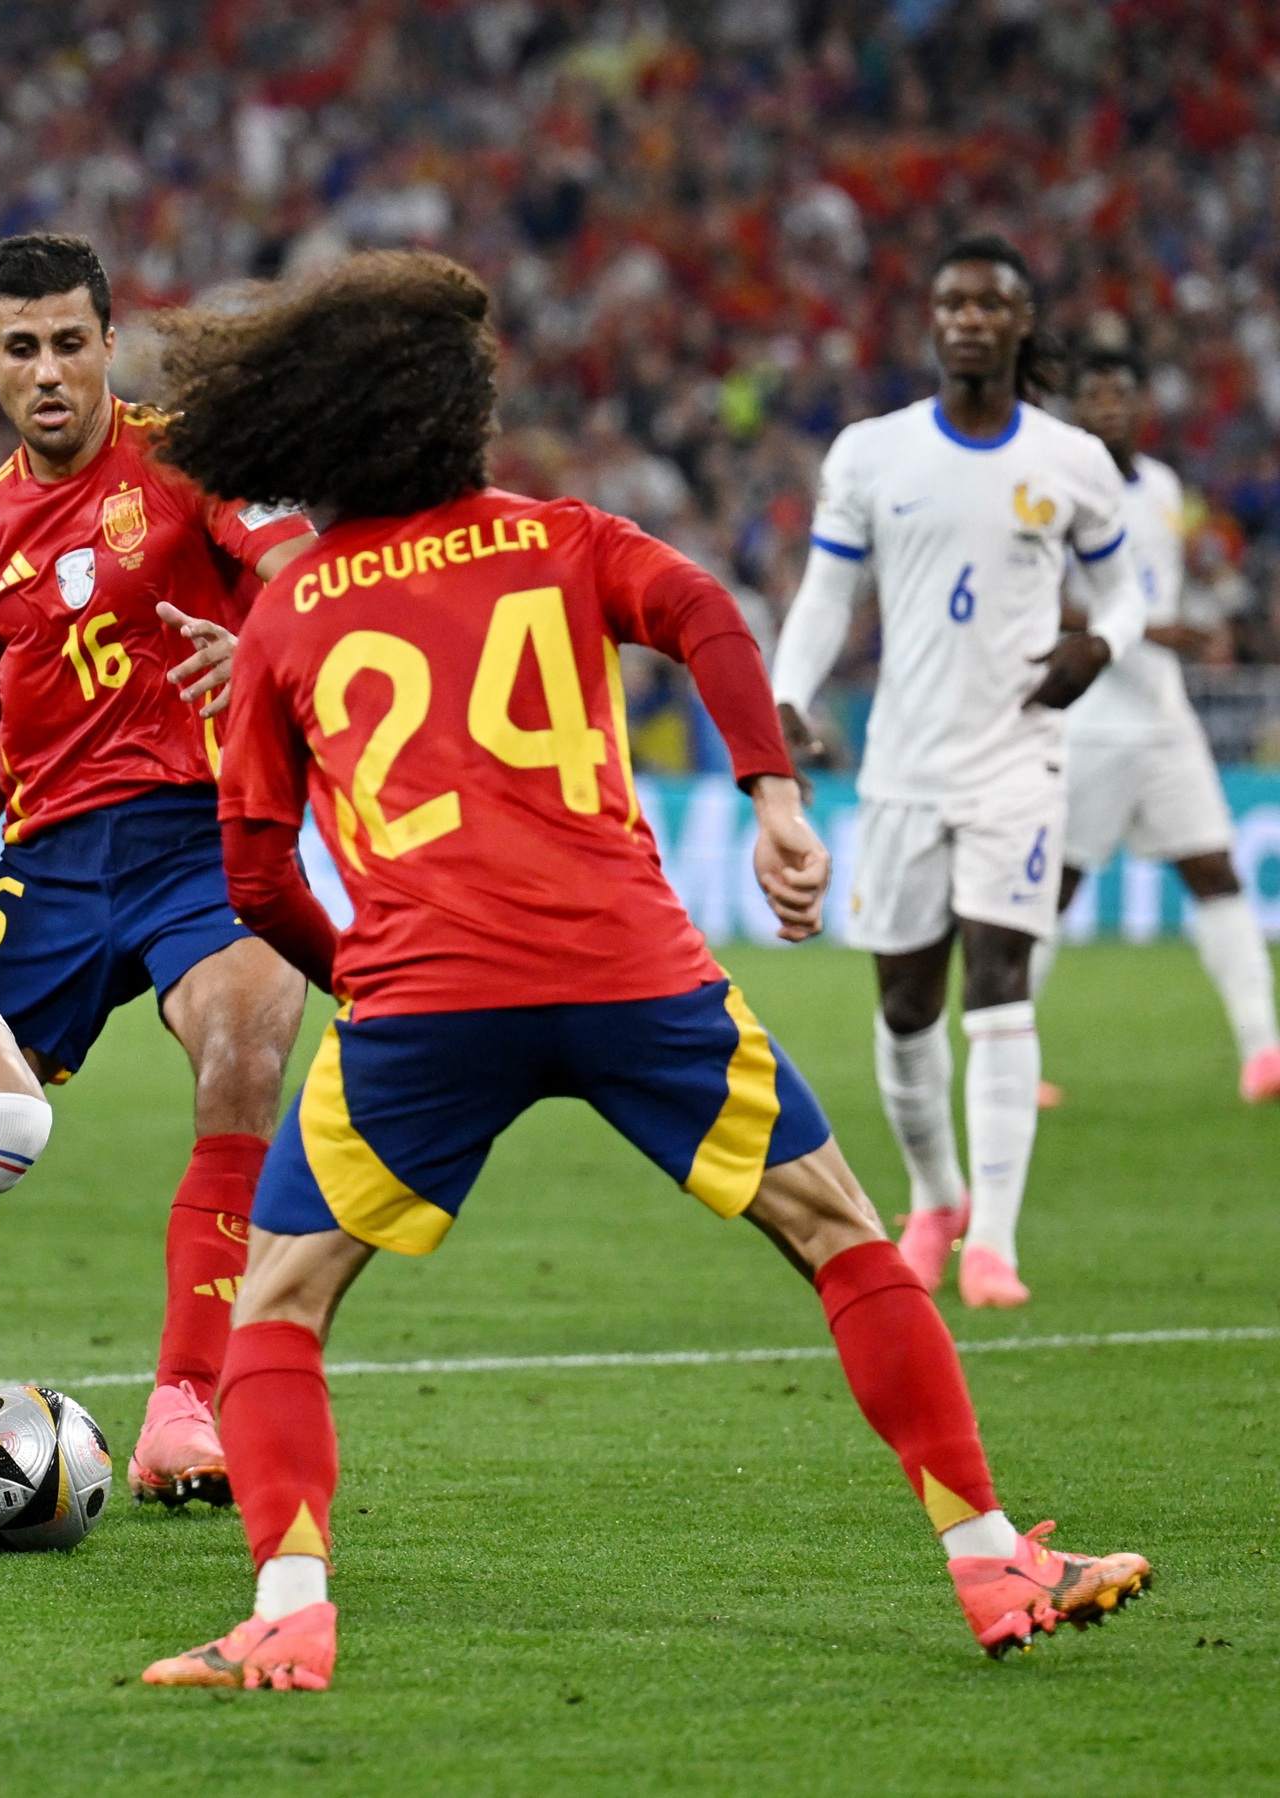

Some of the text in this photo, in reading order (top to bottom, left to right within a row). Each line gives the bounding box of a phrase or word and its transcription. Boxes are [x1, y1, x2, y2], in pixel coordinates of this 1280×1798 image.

[293, 518, 549, 614] CUCURELLA
[949, 563, 975, 625] 6
[61, 611, 132, 701] 16
[313, 586, 607, 861] 24
[1025, 824, 1047, 884] 6
